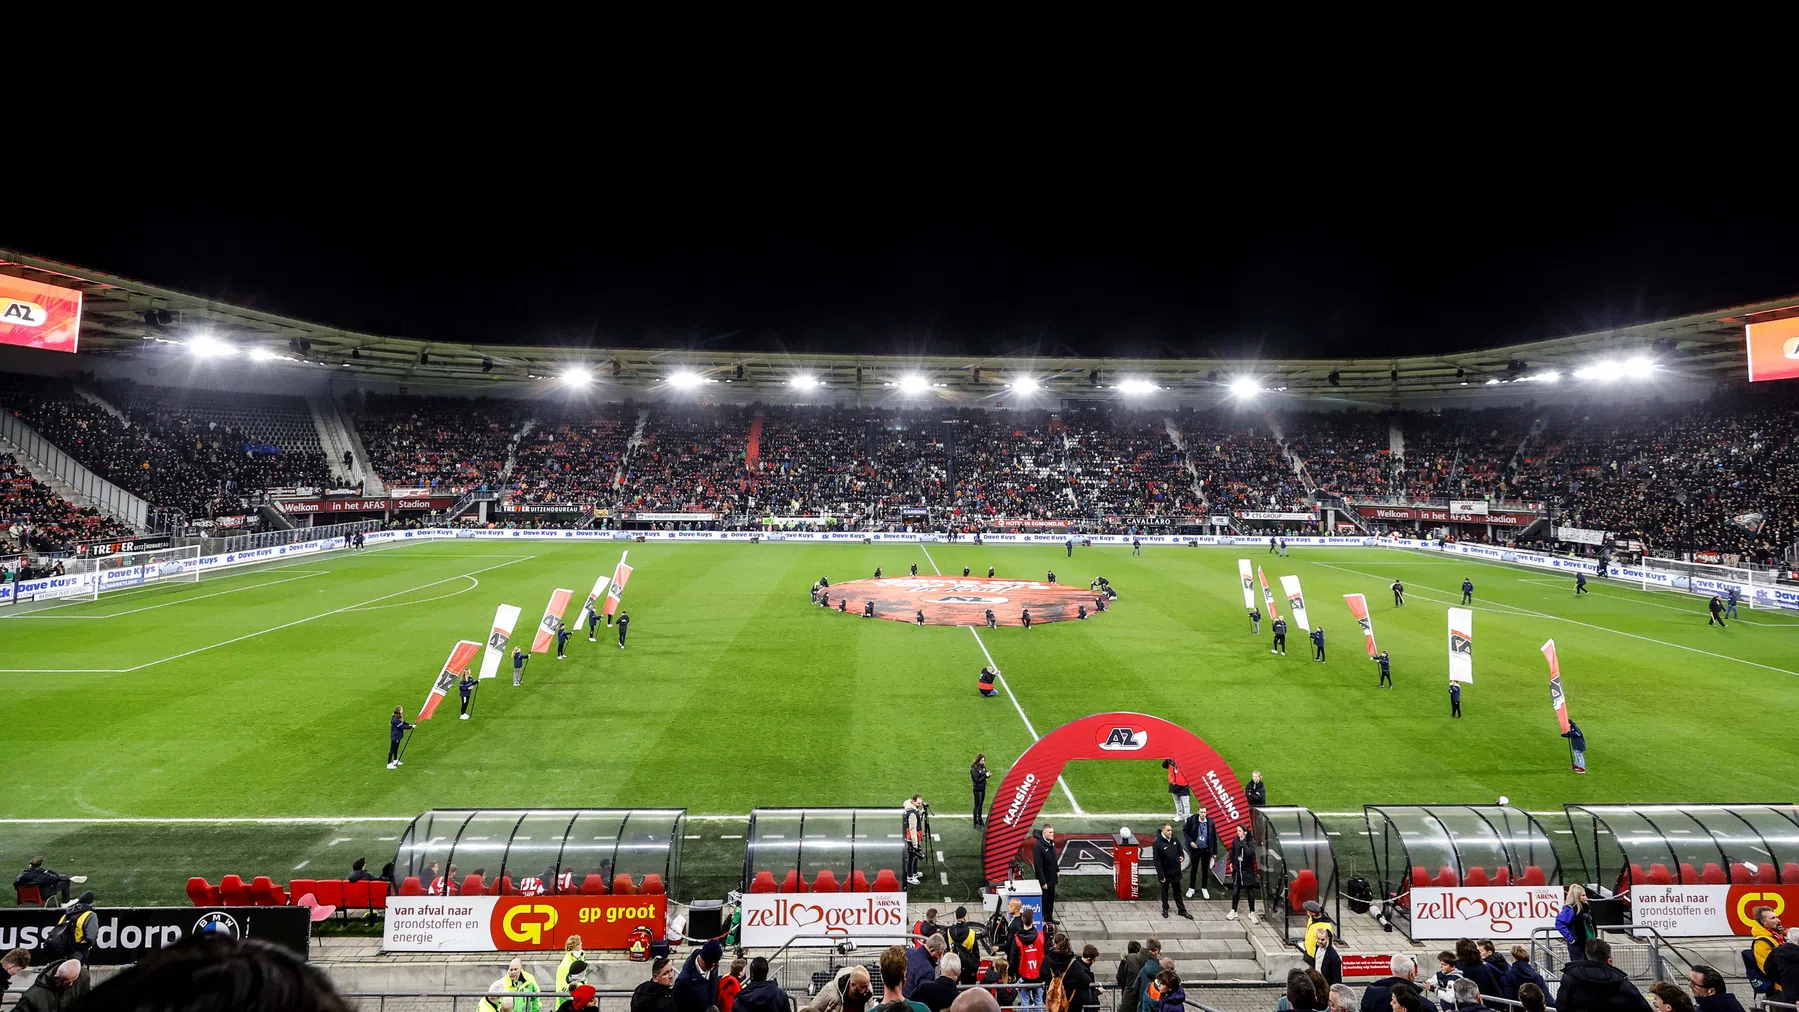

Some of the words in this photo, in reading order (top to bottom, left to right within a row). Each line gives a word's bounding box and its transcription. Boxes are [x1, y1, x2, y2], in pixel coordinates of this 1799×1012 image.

[4, 303, 35, 322] AZ
[285, 503, 319, 512] Welkom
[333, 502, 341, 510] in
[345, 501, 360, 510] het
[362, 501, 385, 509] AFAS
[398, 500, 430, 508] Stadion
[1376, 509, 1409, 518] Welkom
[1421, 511, 1429, 519] in
[1432, 511, 1446, 520] het
[1485, 514, 1517, 524] Stadion
[93, 542, 134, 556] TREFFER
[305, 541, 318, 550] Kuys
[238, 551, 255, 559] Dave
[256, 549, 272, 557] Kuys
[1485, 549, 1499, 557] Kuys
[1529, 555, 1545, 563] Kuys
[199, 556, 218, 566] Kuys
[1563, 560, 1581, 568] Dave
[107, 569, 132, 579] Dave
[1623, 569, 1643, 578] Dave
[17, 581, 48, 593] Dave
[50, 577, 77, 588] Kuys
[1104, 727, 1139, 746] AZ
[1131, 861, 1139, 886] FUTURE
[1131, 885, 1139, 897] THE
[1639, 895, 1657, 903] van
[1660, 893, 1683, 903] afval
[1686, 895, 1709, 903] naar
[395, 906, 415, 916] van
[418, 904, 445, 916] afval
[448, 906, 473, 916] naar
[578, 907, 601, 923] gp
[606, 903, 656, 923] groot
[1640, 905, 1701, 917] grondstoffen
[1704, 907, 1716, 915] en
[199, 914, 234, 928] BMW
[394, 918, 463, 931] grondstoffen
[465, 920, 479, 929] en
[1641, 919, 1677, 930] energie
[392, 932, 433, 945] energie
[1028, 960, 1037, 970] TV
